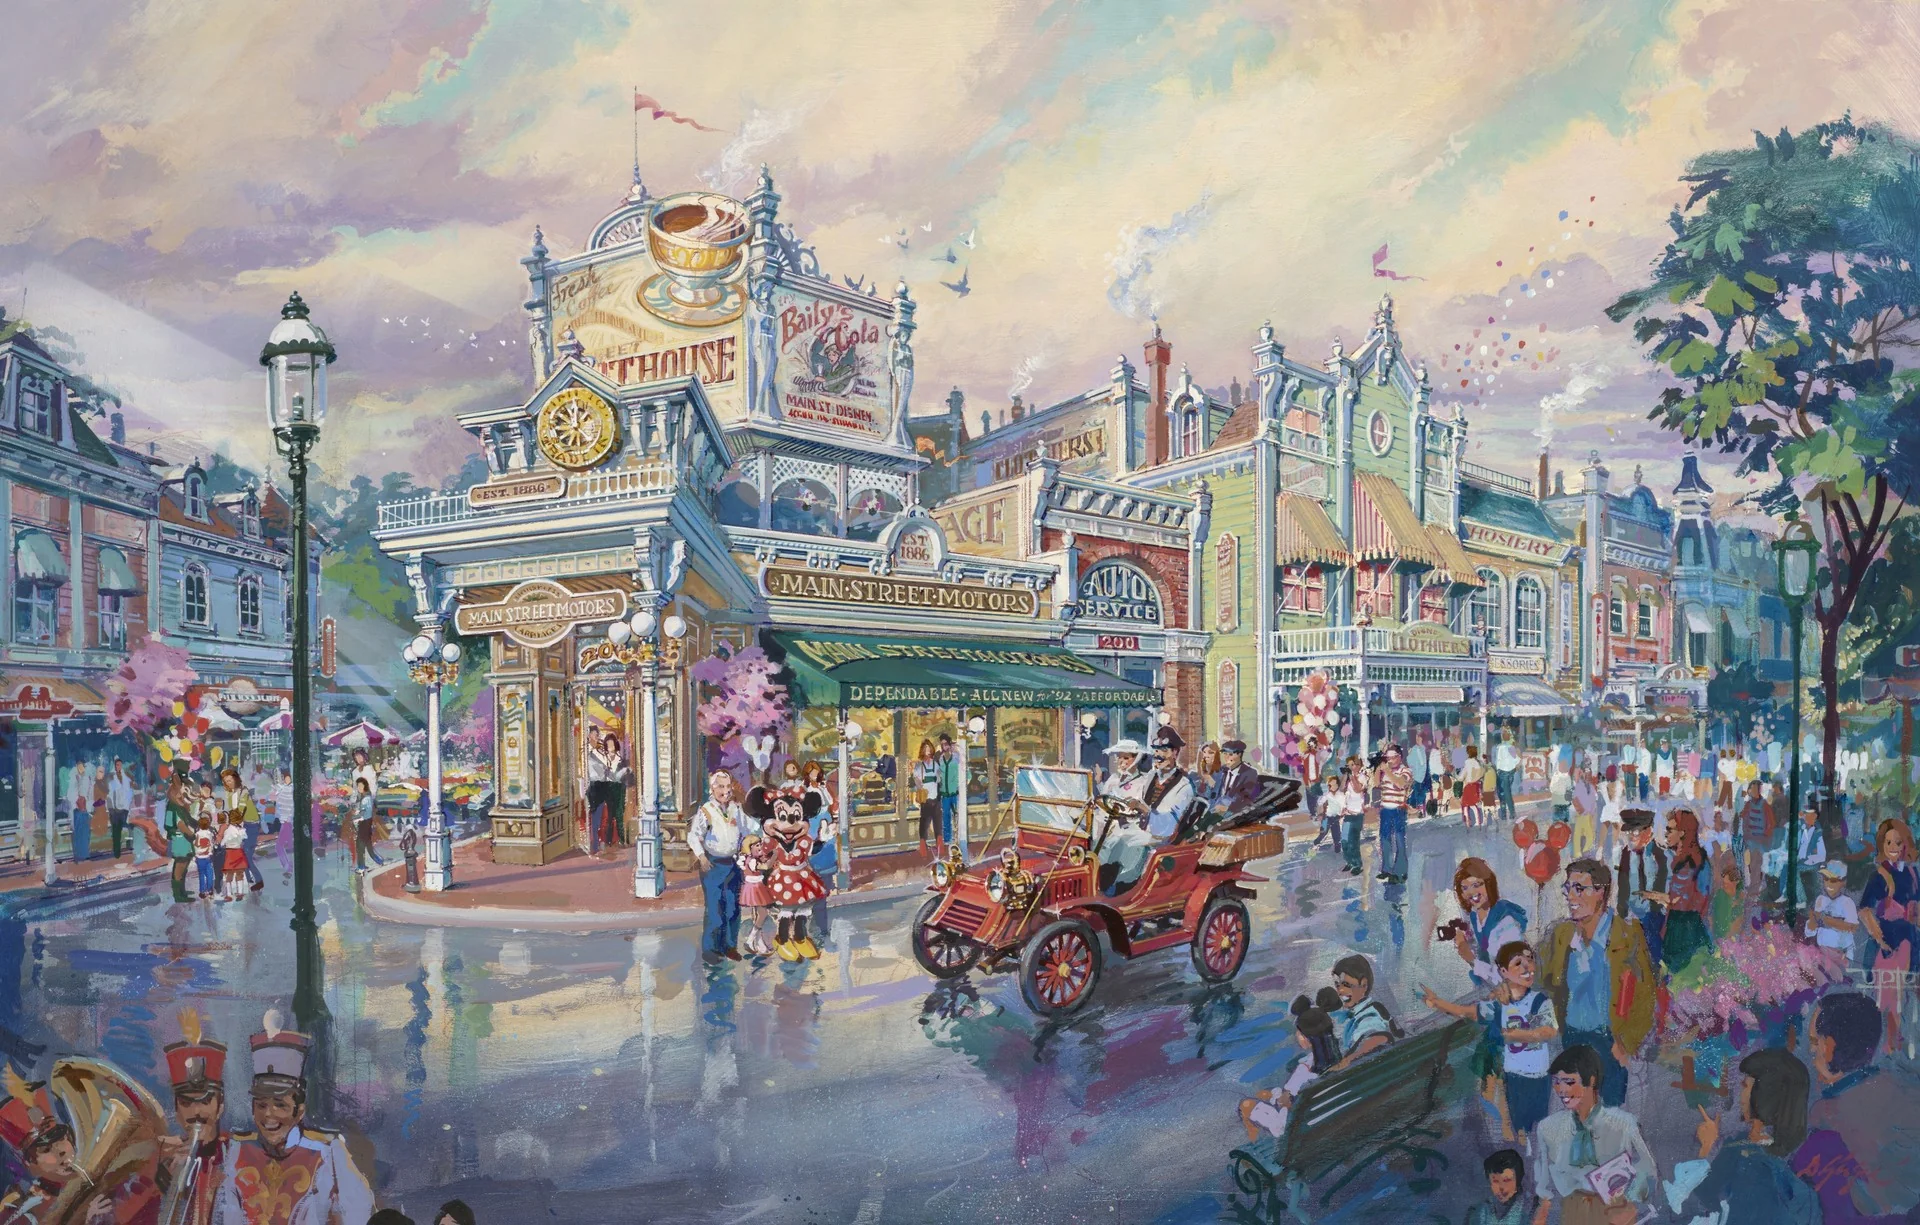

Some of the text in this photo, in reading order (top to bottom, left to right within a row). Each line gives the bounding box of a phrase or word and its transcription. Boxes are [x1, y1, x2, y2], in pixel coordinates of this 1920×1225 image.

[552, 263, 598, 312] Fresh
[777, 300, 854, 353] Baily's
[820, 318, 879, 351] Cola
[598, 335, 736, 385] THOUSE
[902, 533, 928, 545] EST
[900, 546, 931, 561] 1886
[1083, 565, 1147, 601] AUTO
[467, 608, 503, 625] MAIN
[1078, 599, 1157, 620] SERVICE
[1101, 635, 1135, 649] 200
[849, 685, 958, 701] DEPENDABLE
[1002, 689, 1034, 702] NEW
